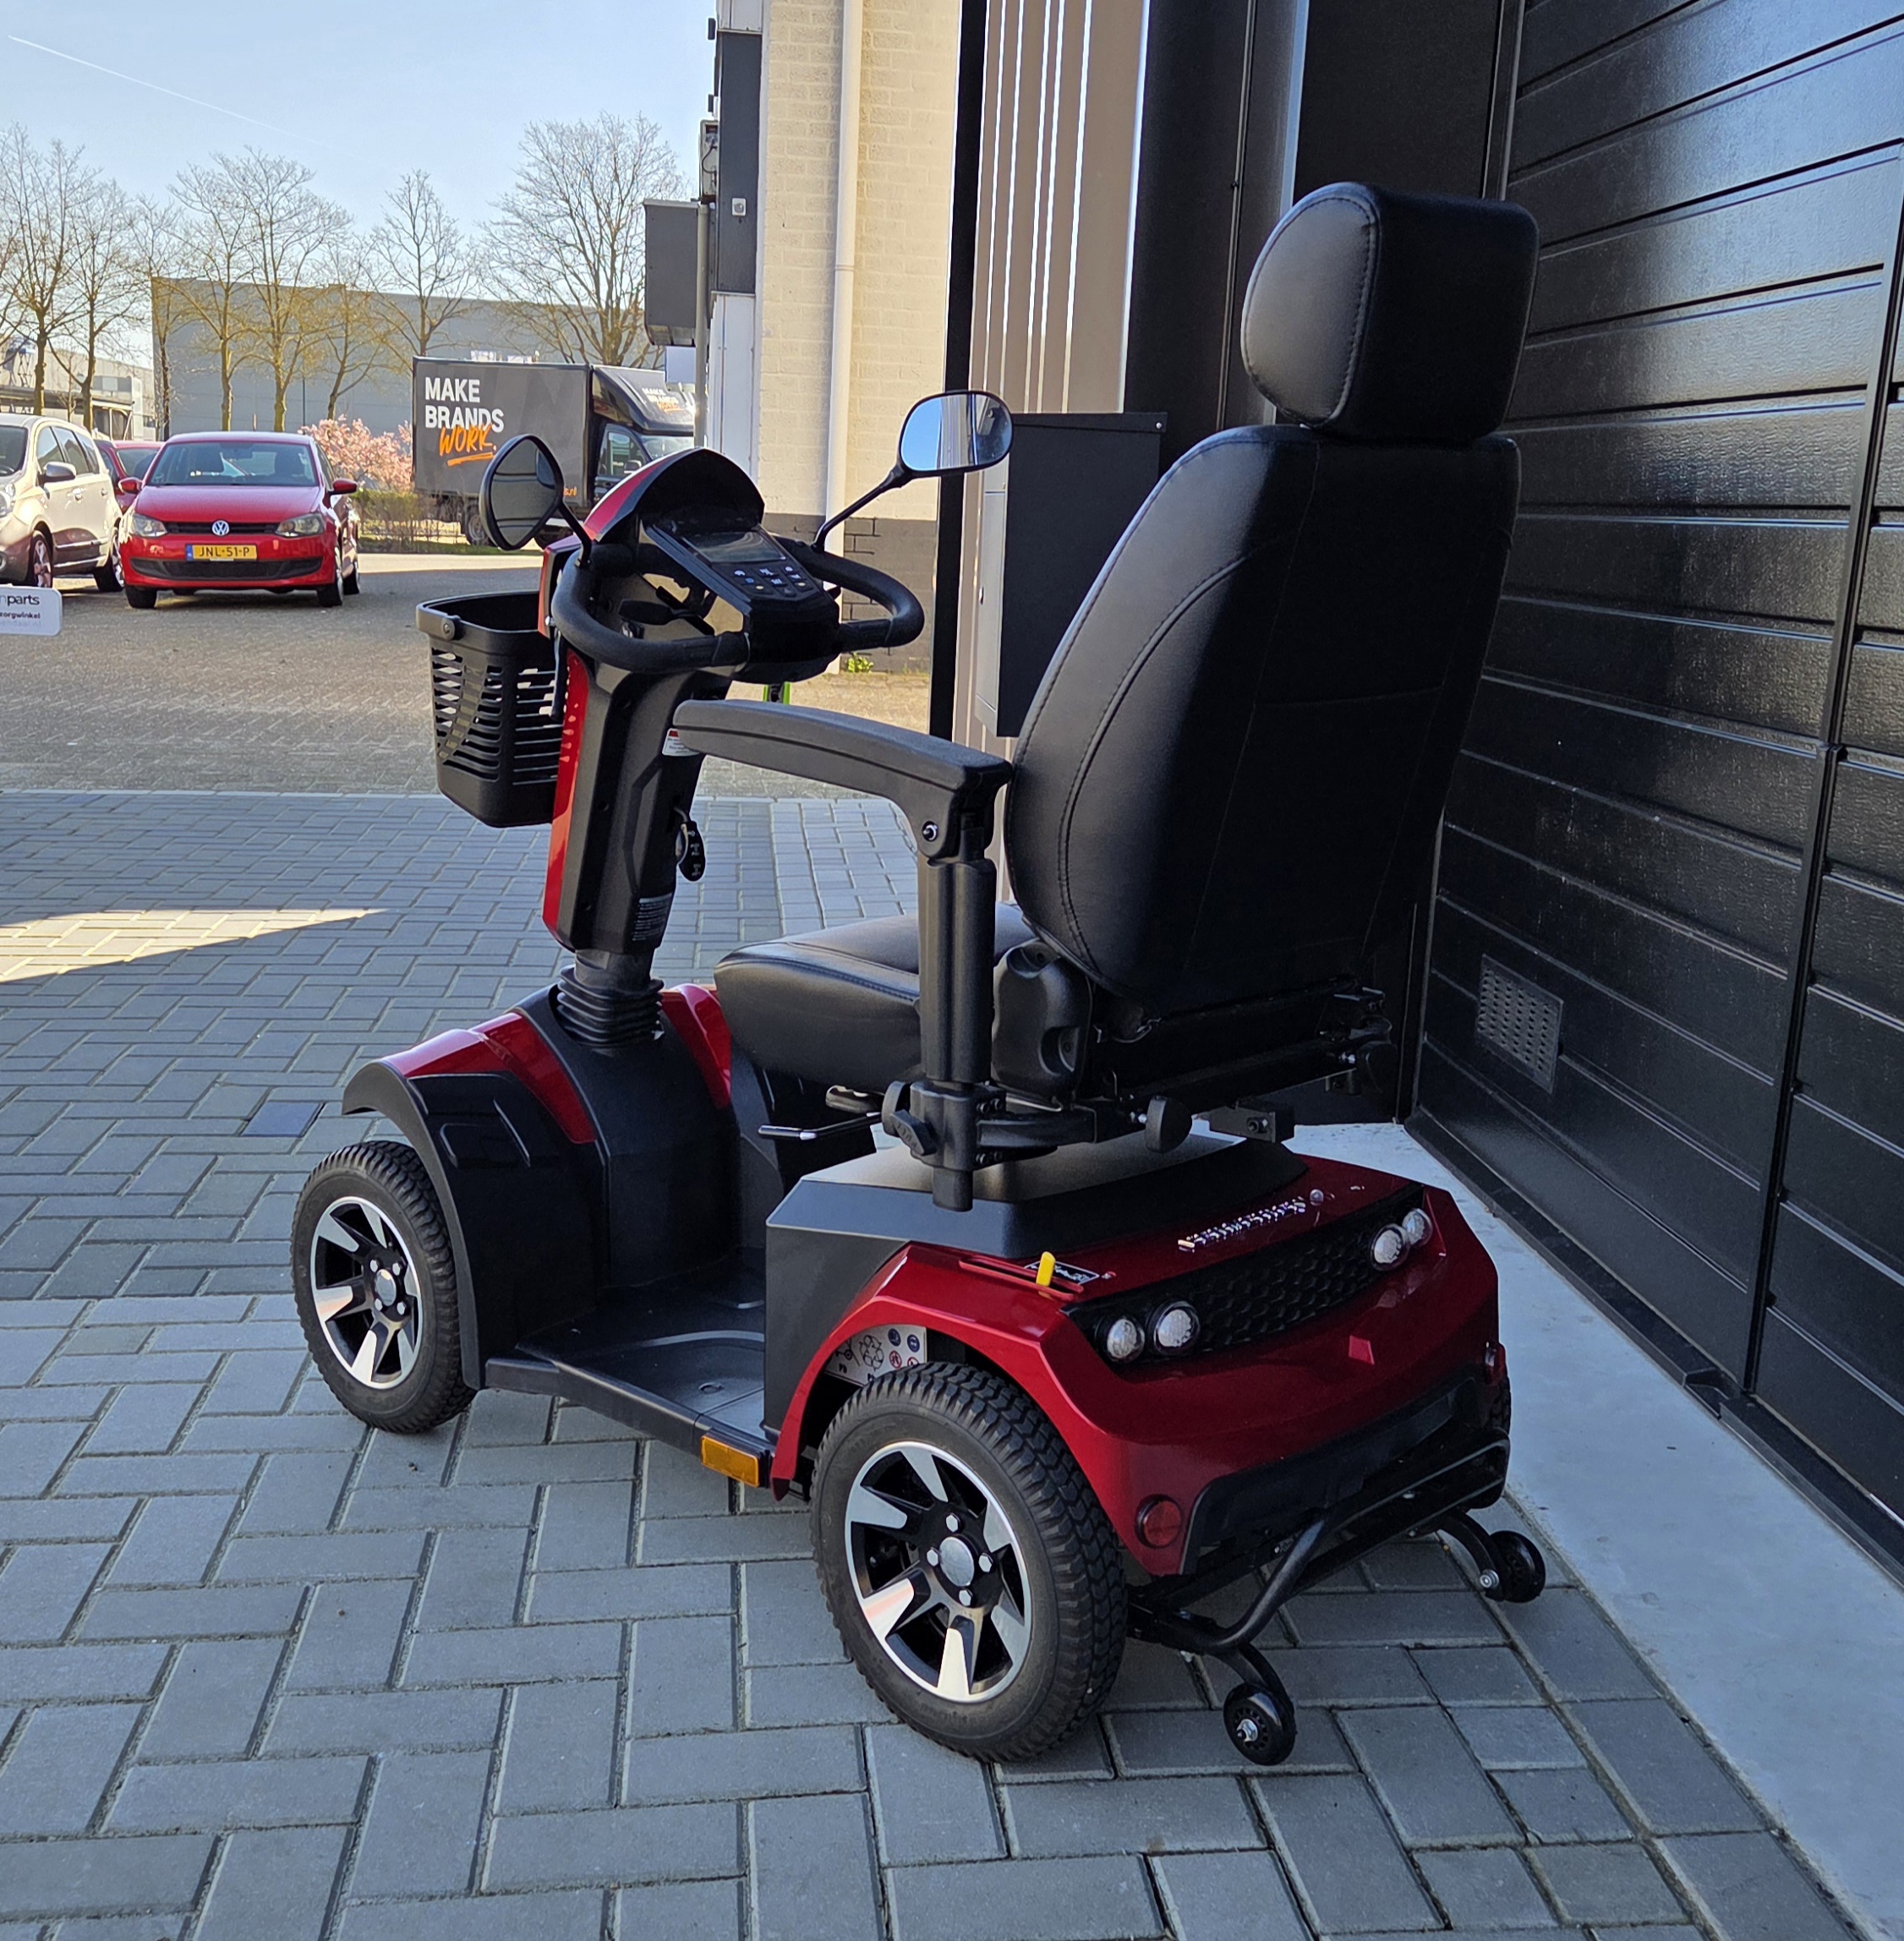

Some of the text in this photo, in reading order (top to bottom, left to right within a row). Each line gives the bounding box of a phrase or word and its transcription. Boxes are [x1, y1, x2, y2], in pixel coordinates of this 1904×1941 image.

[425, 377, 480, 402] MAKE
[425, 405, 505, 433] BRANDS
[439, 423, 497, 457] WORK.
